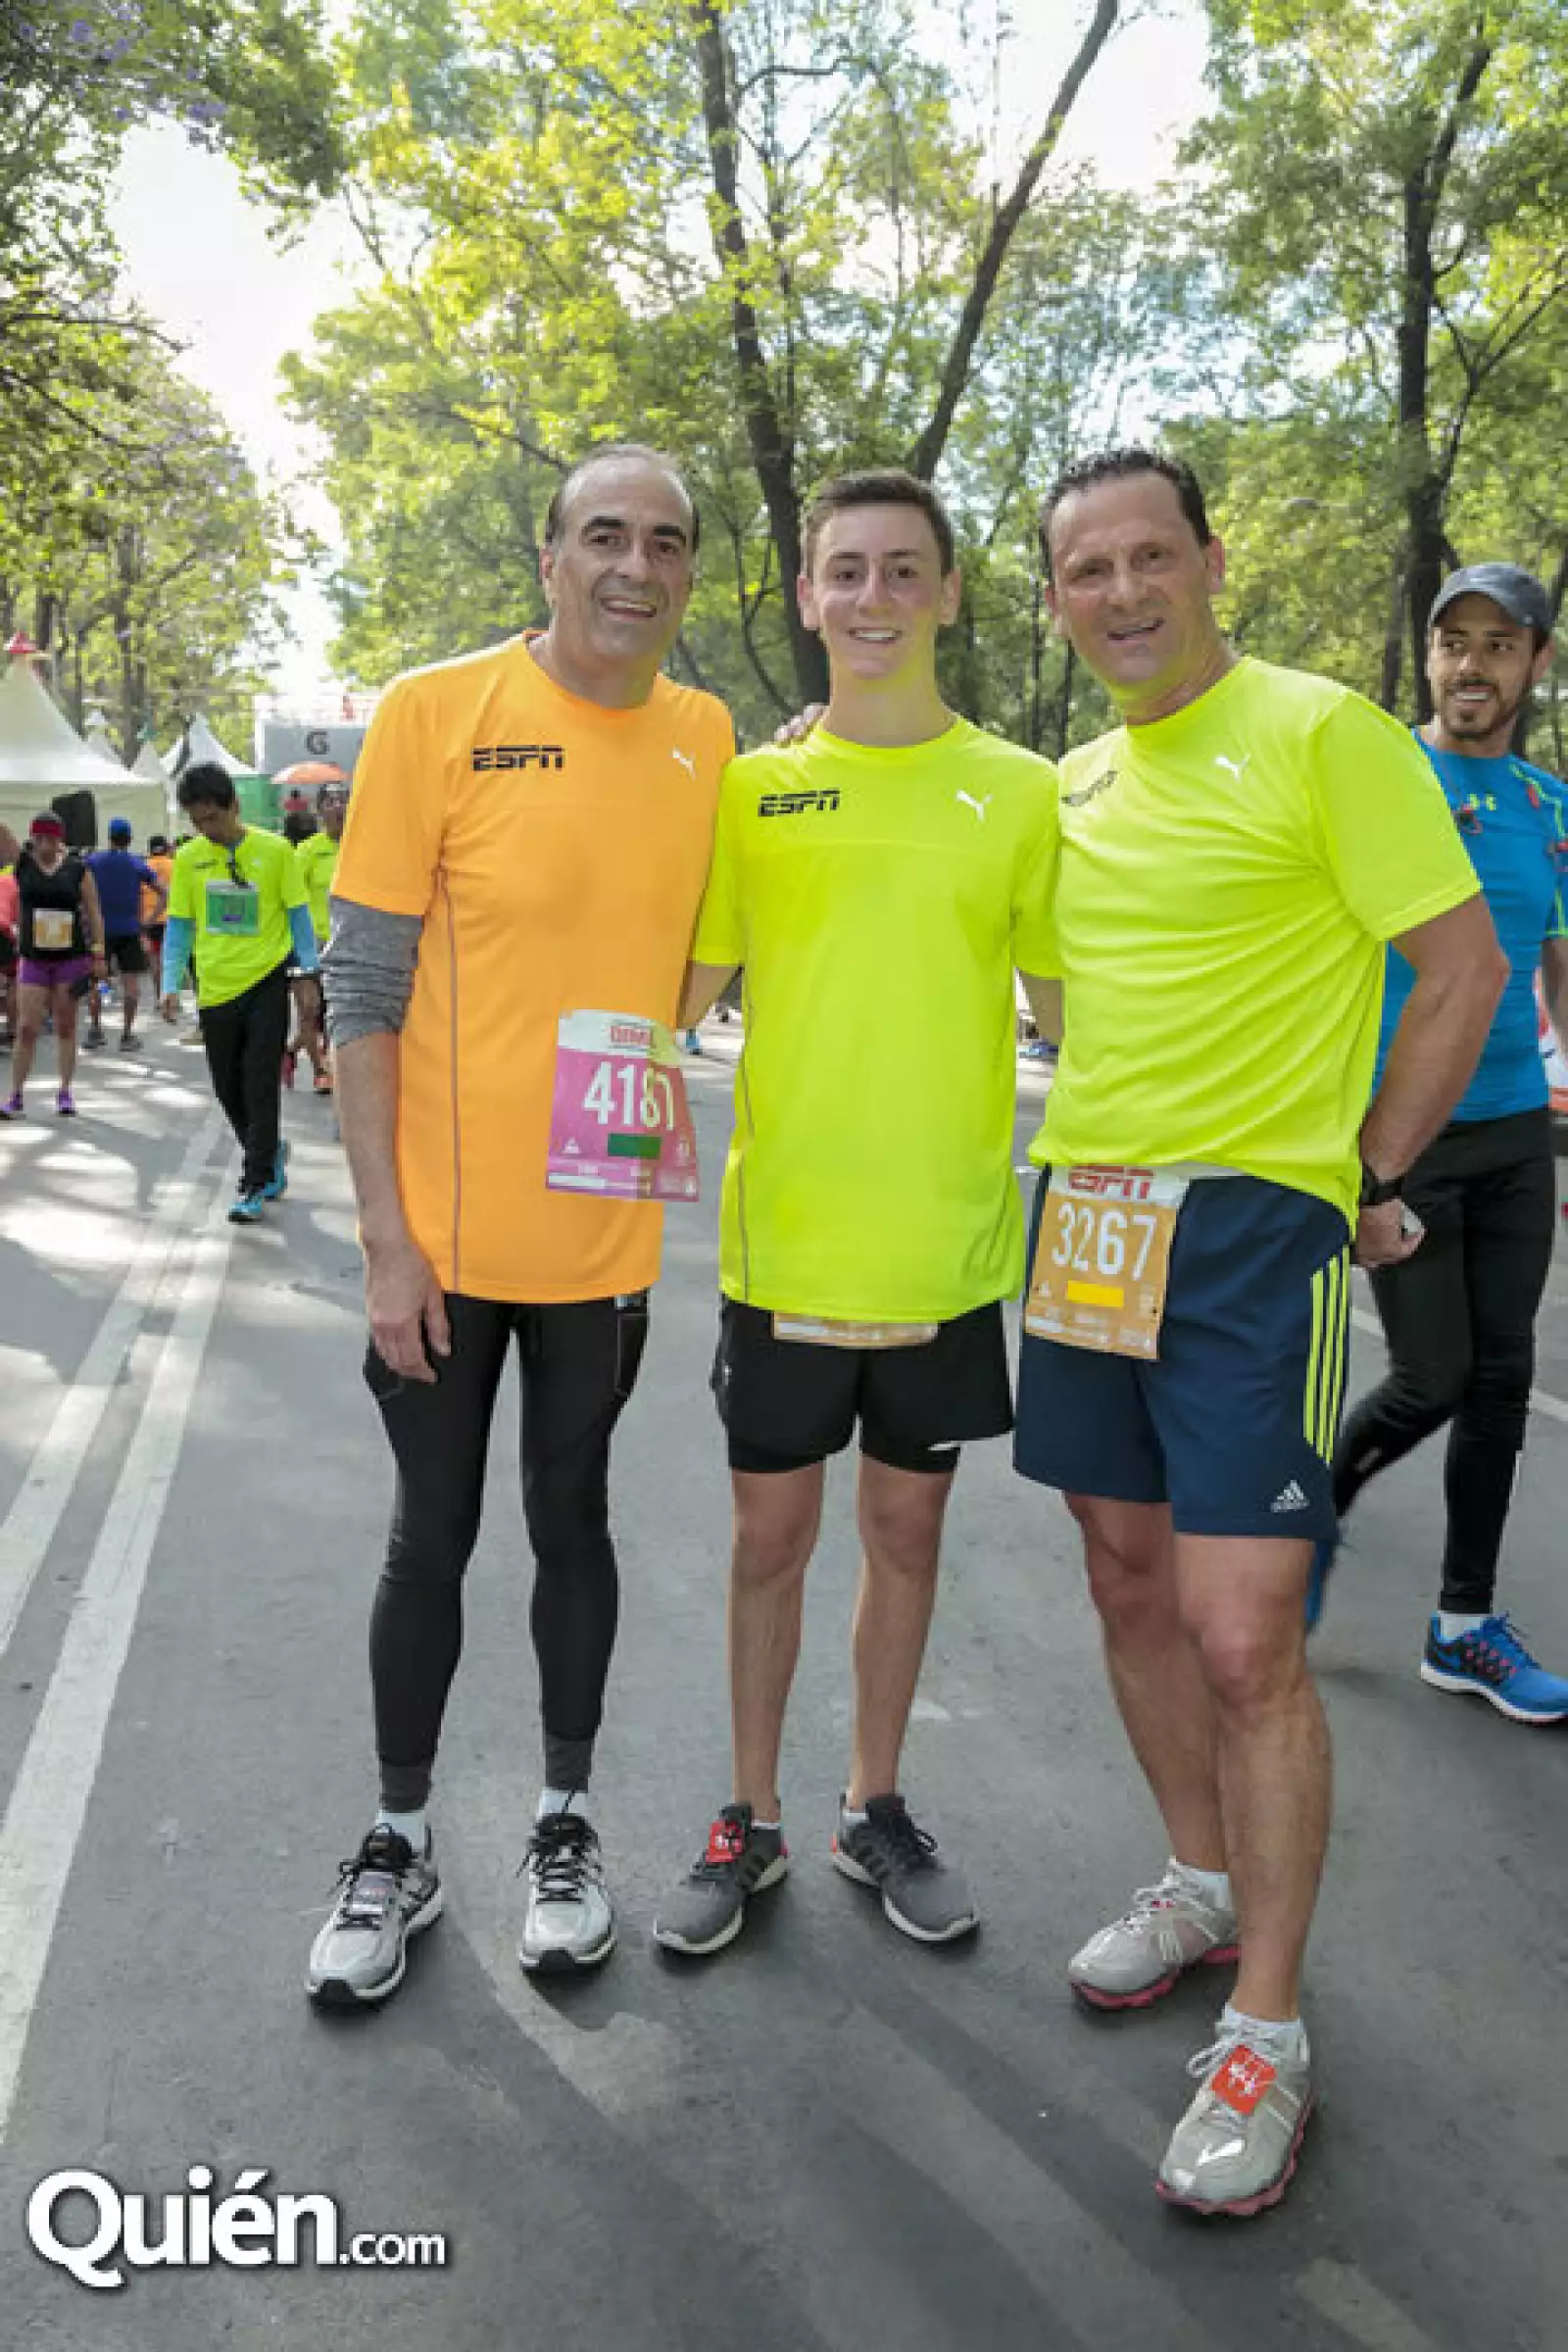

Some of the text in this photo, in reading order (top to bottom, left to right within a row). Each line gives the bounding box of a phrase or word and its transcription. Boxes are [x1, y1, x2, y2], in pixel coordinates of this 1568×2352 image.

[305, 730, 331, 756] G
[471, 744, 564, 771] ESPN
[758, 789, 841, 817] ESPN
[1051, 1201, 1157, 1281] 3267
